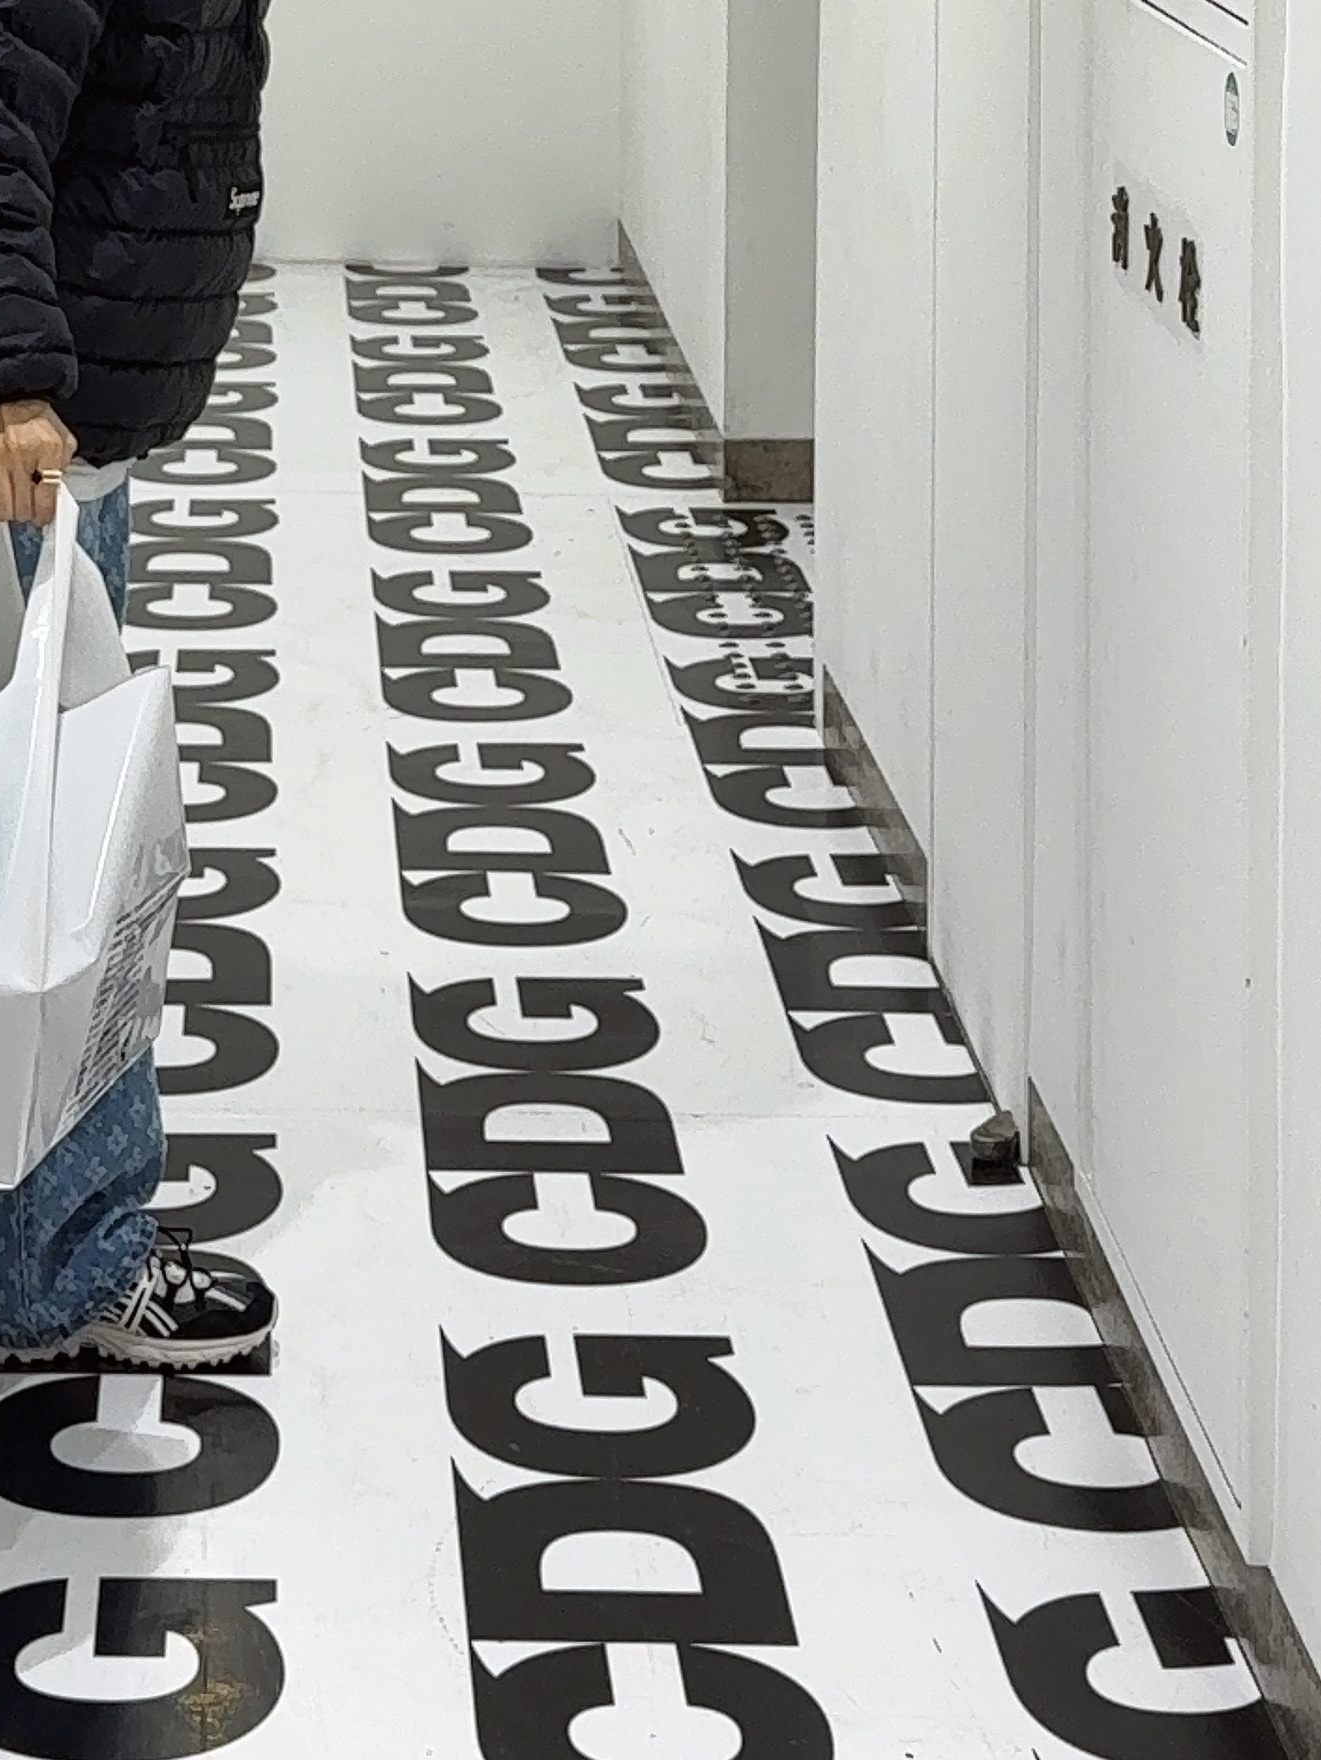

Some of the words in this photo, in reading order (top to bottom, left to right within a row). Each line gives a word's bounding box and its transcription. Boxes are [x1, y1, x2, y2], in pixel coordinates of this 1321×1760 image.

[350, 334, 503, 425] CDG
[543, 293, 680, 372] CDG
[359, 436, 533, 554] CDG
[574, 381, 725, 490] CDG
[125, 498, 280, 630] CDG
[614, 504, 814, 639] CDG
[371, 567, 573, 722] CDG
[663, 654, 870, 828] CDG
[385, 741, 628, 947] CDG
[729, 847, 994, 1105] CDG
[408, 972, 709, 1287] CDG
[826, 1134, 1188, 1533] CDG
[439, 1324, 836, 1760] CDG
